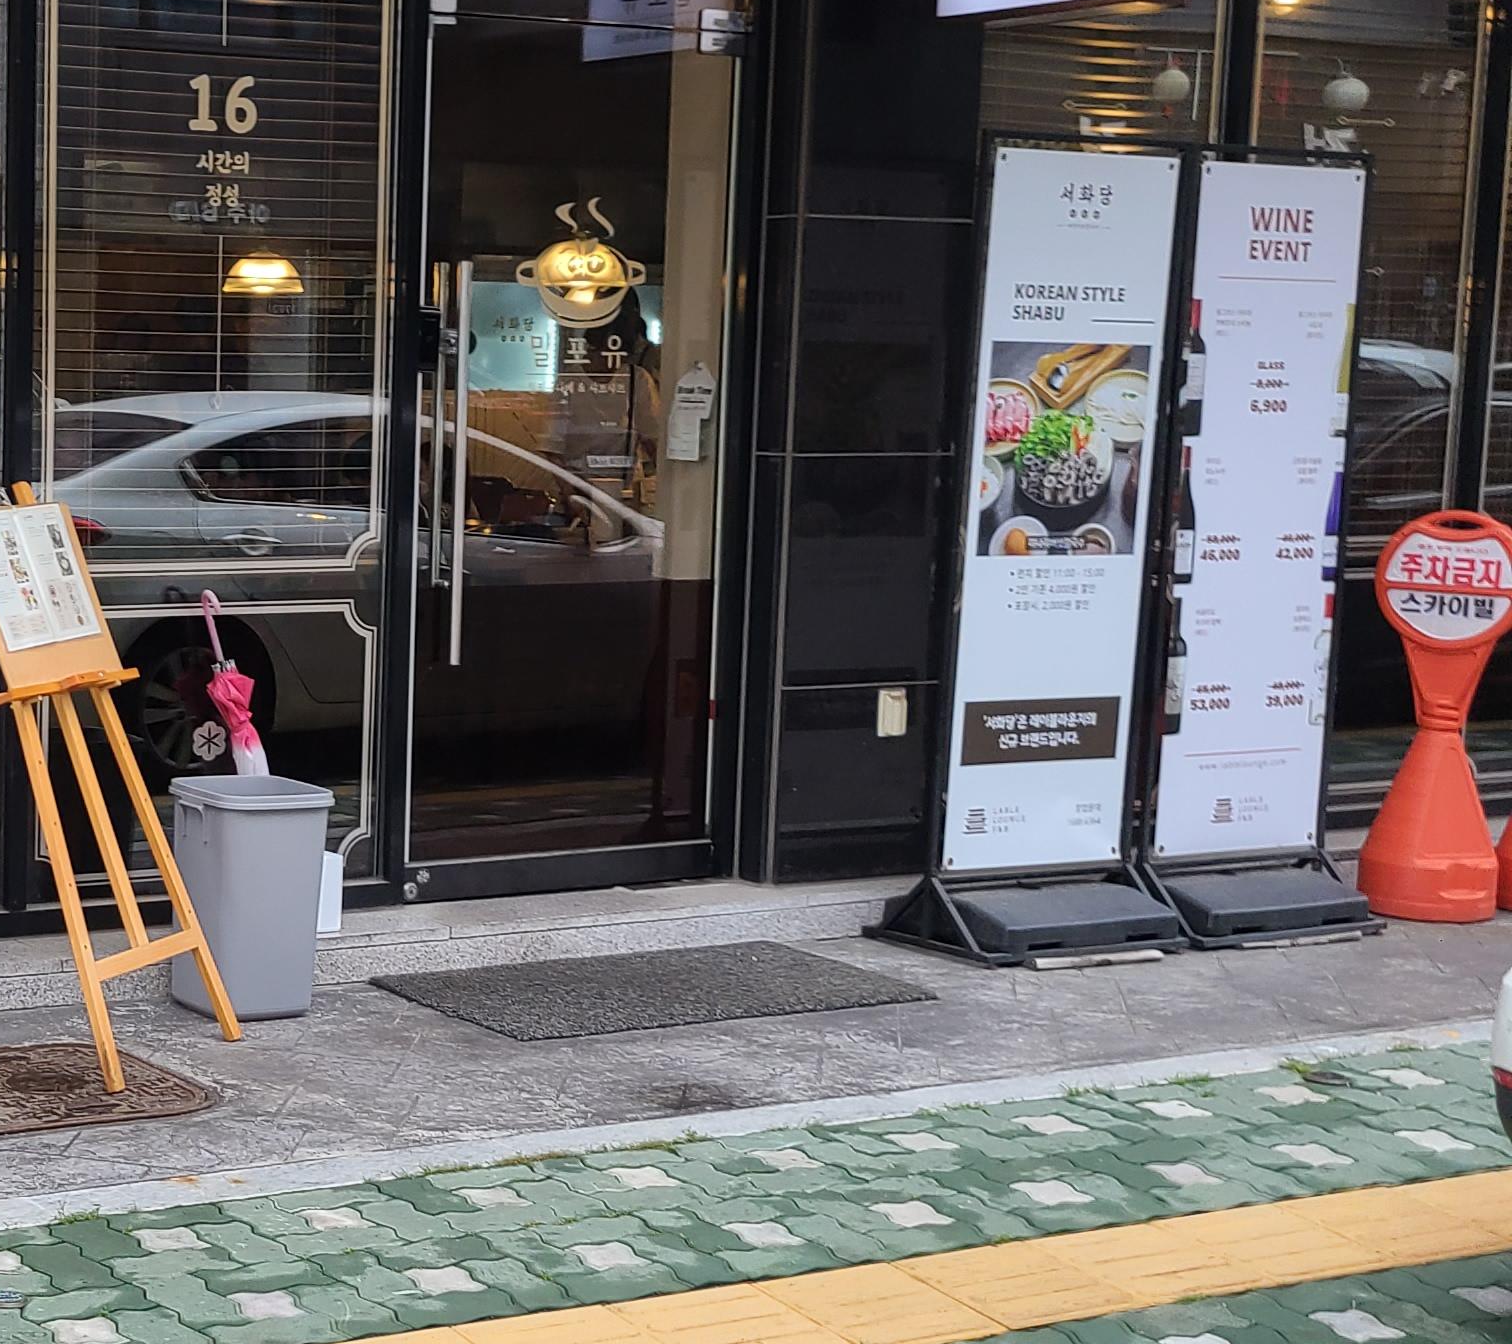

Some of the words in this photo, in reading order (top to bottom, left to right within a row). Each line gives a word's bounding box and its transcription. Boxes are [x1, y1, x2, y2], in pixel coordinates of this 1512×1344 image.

[188, 74, 258, 134] 16
[196, 150, 249, 174] 시간의
[205, 183, 239, 207] 정성
[1250, 206, 1314, 233] WINE
[1248, 239, 1312, 262] EVENT
[1014, 284, 1078, 301] KOREAN
[1081, 286, 1125, 302] STYLE
[1012, 305, 1065, 321] SHABU
[532, 333, 628, 368] 밀포유
[1250, 399, 1287, 414] 6,900
[1400, 553, 1501, 588] 주차금지
[1400, 593, 1494, 620] 스카이빌
